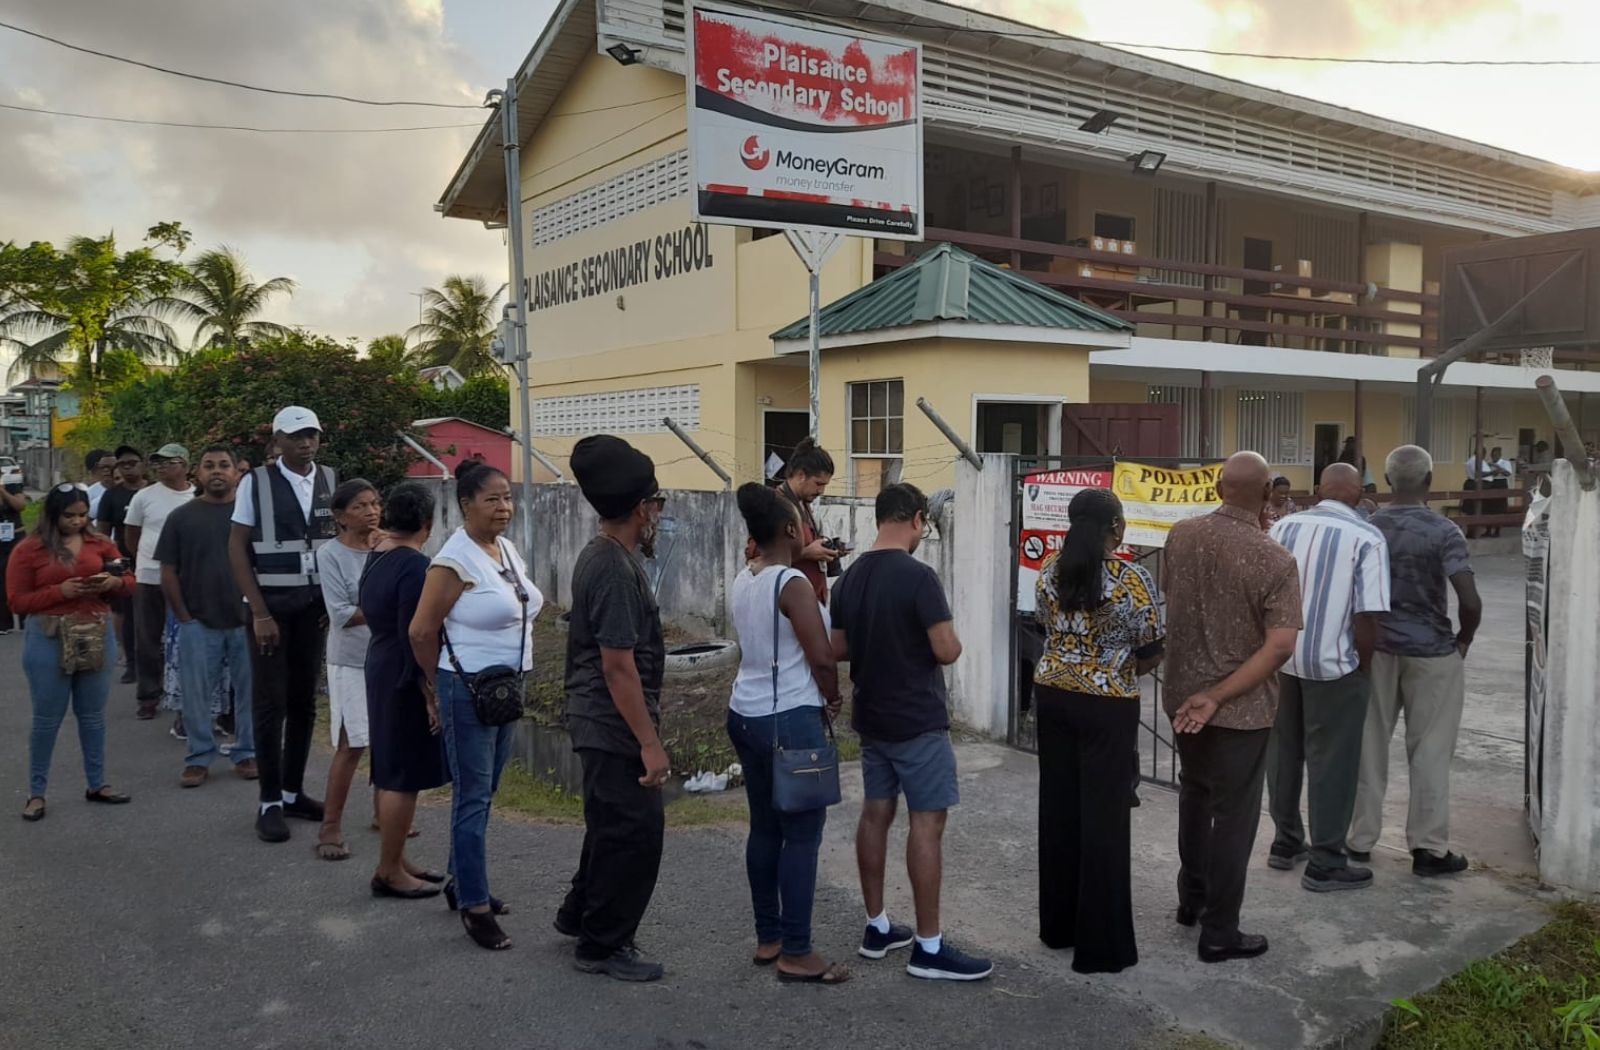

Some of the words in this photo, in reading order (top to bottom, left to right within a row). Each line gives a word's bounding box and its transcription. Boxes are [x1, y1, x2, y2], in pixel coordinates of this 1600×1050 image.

[763, 43, 868, 84] Plaisance
[717, 68, 831, 113] Secondary
[840, 87, 904, 119] School
[775, 150, 884, 180] MoneyGram
[775, 175, 812, 190] money
[814, 177, 855, 193] transfer
[846, 215, 868, 224] Please
[869, 217, 885, 225] Drive
[886, 219, 913, 230] Carefully
[581, 238, 652, 298] SECONDARY
[654, 223, 713, 280] SCHOOL
[1035, 471, 1102, 486] WARNING
[1150, 486, 1217, 503] PLACE
